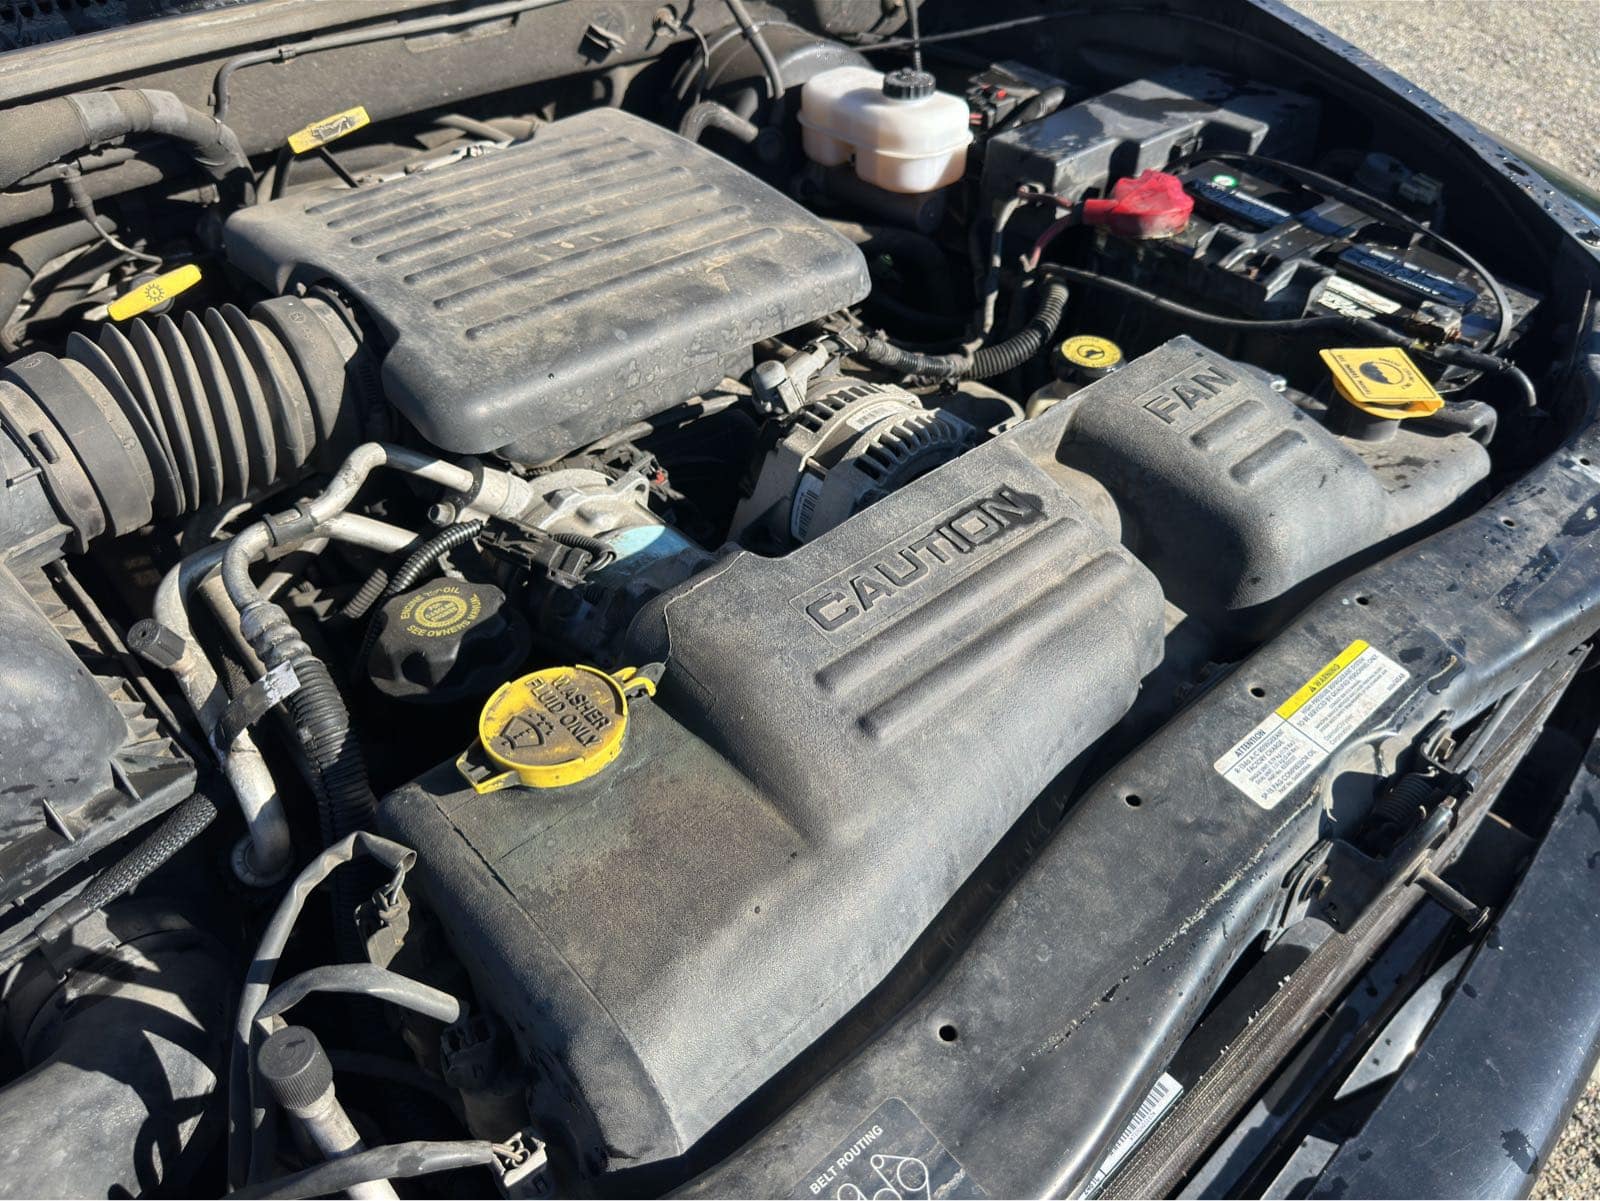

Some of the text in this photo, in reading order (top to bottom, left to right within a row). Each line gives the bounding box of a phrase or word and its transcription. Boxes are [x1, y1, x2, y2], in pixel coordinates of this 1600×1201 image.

[1144, 366, 1240, 424] FAN
[805, 491, 1027, 632] CAUTION
[400, 595, 423, 620] ENGINE
[443, 586, 460, 594] OIL
[406, 624, 426, 637] SEE
[1315, 663, 1340, 686] WARNING
[525, 676, 603, 748] FLUID ONLY
[551, 675, 611, 731] WASHER
[1234, 728, 1266, 757] ATTENTION
[1246, 754, 1266, 773] FACTORY
[1264, 739, 1284, 756] CHARGE
[809, 1124, 884, 1195] BELT ROUTING
